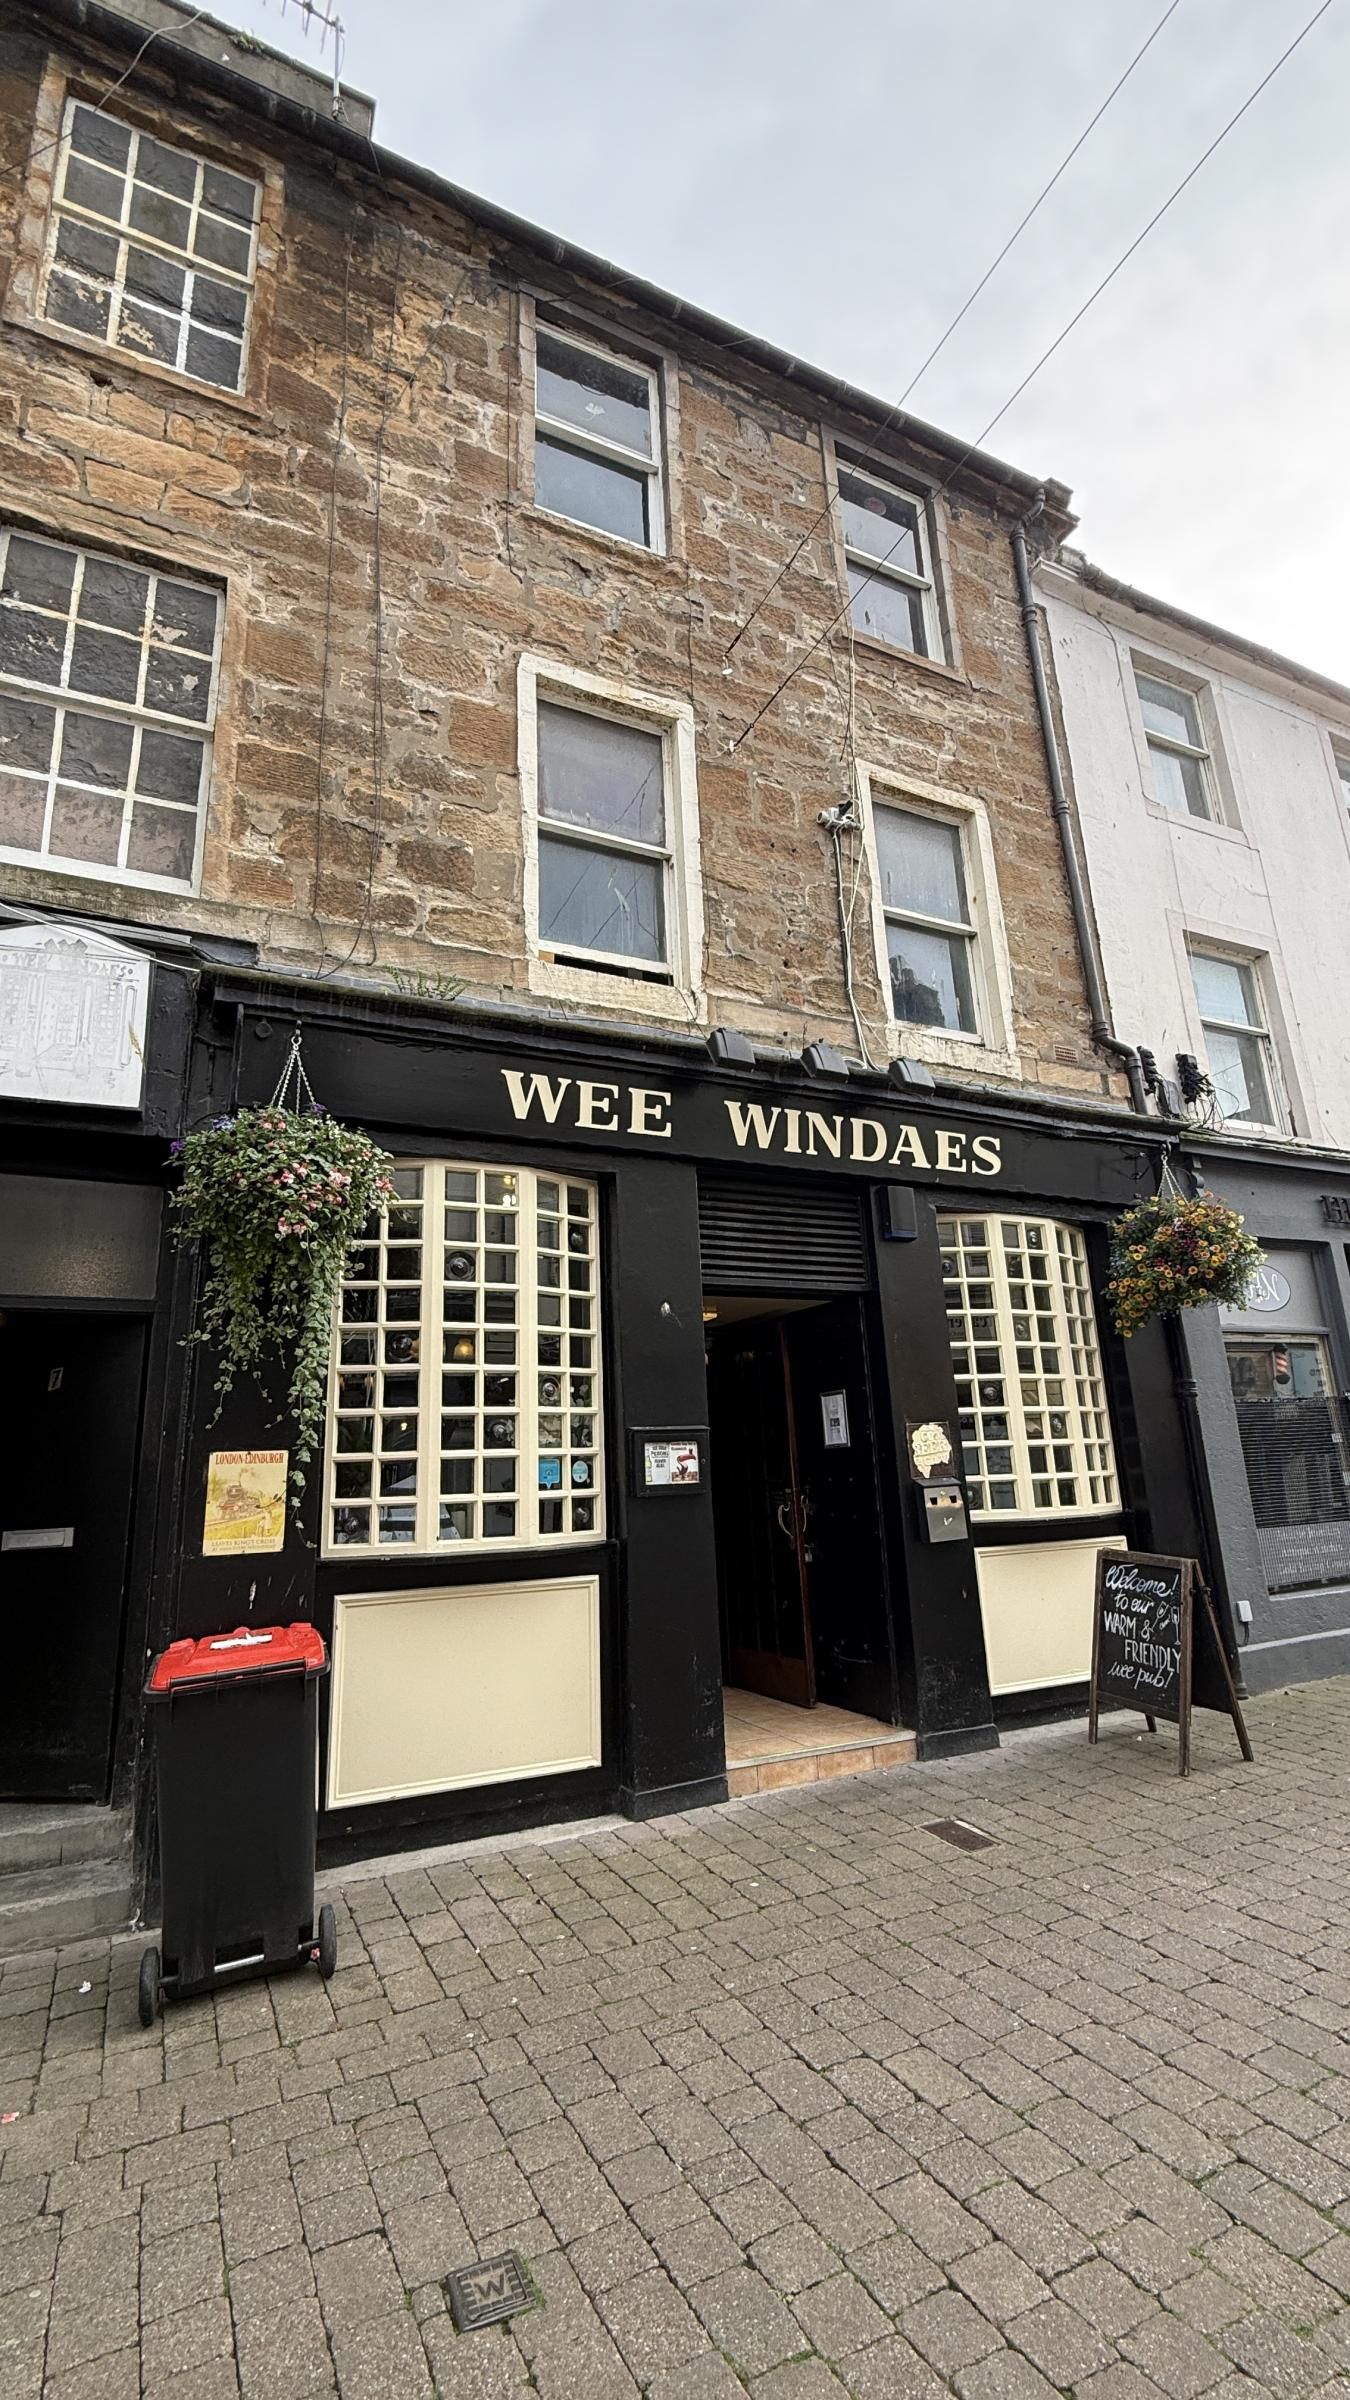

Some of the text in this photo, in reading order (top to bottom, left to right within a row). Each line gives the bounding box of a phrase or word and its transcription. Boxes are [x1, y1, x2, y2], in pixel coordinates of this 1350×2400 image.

[500, 1068, 1002, 1176] WEE WINDAES
[1105, 1564, 1179, 1597] Welcome!
[1114, 1589, 1155, 1614] to our
[1104, 1610, 1136, 1639] WARM
[1141, 1619, 1153, 1641] &
[1107, 1661, 1136, 1679] wee
[1125, 1639, 1181, 1674] FRIENDLY
